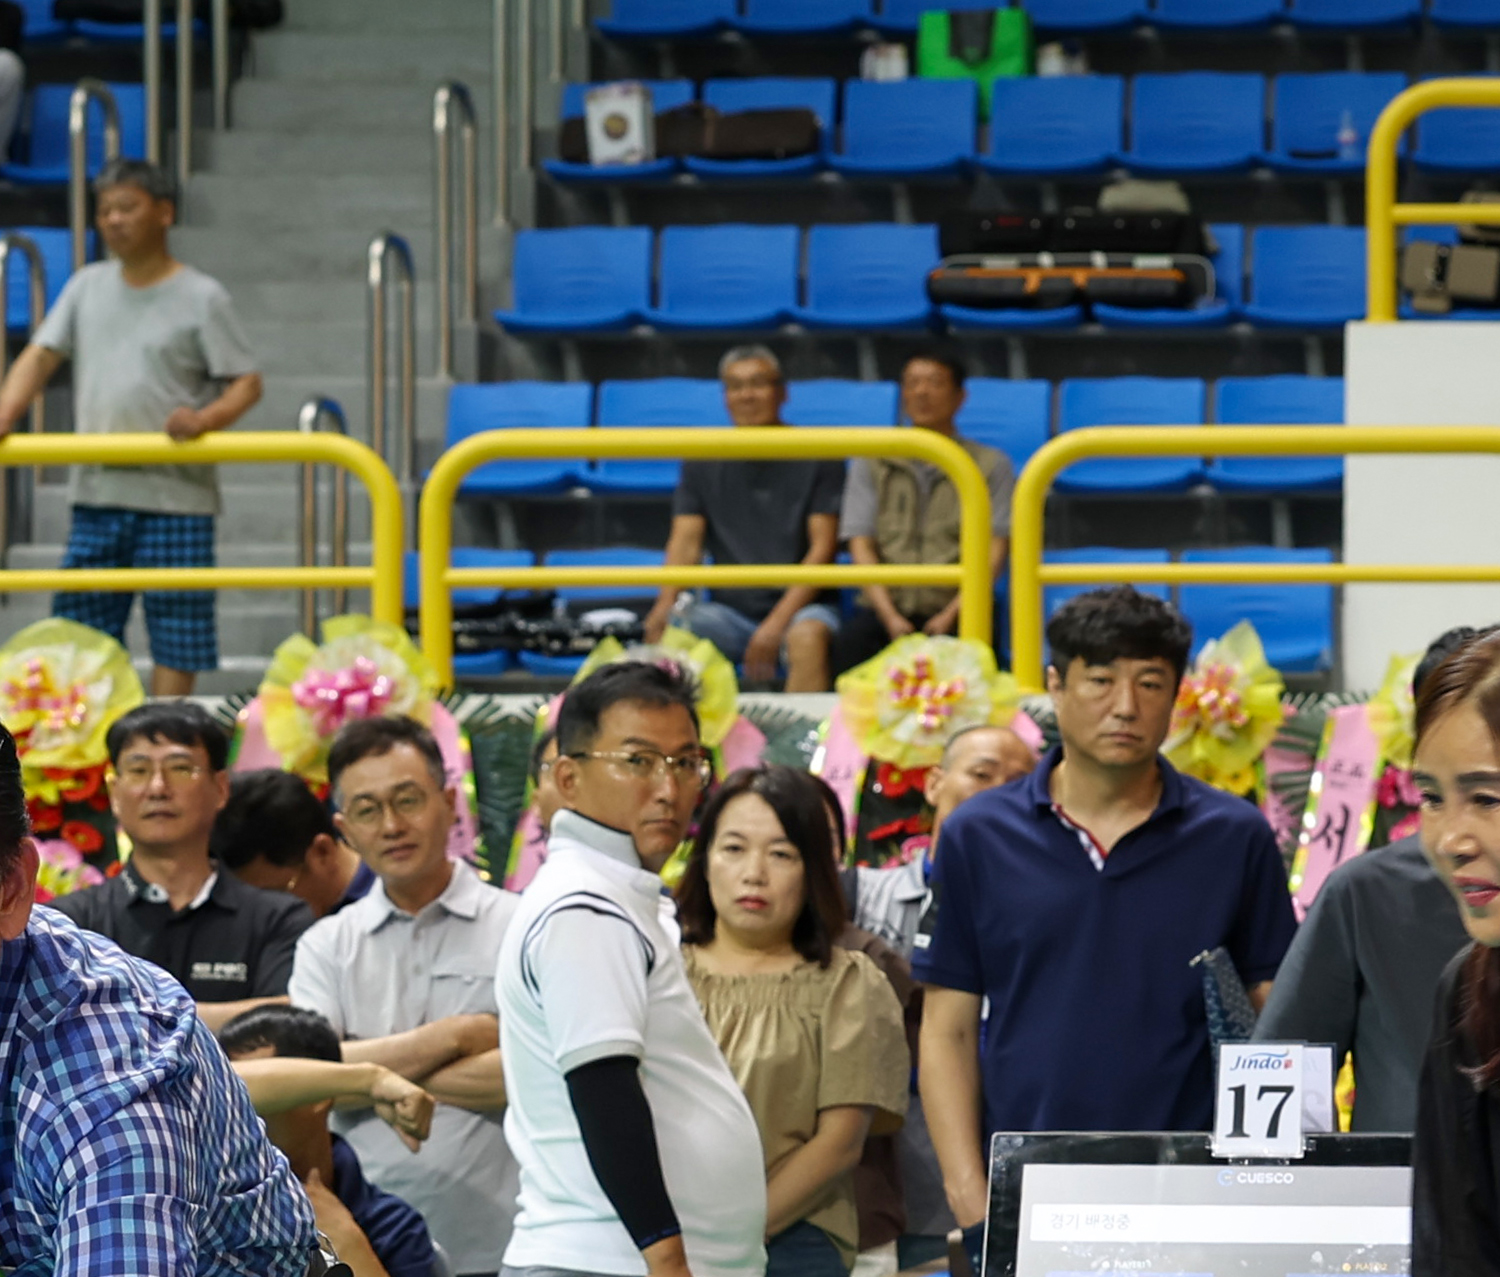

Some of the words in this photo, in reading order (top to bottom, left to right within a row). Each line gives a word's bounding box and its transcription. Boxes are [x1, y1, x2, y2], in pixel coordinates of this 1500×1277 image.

[1229, 1053, 1282, 1071] Jindo
[1225, 1084, 1295, 1139] 17
[1237, 1172, 1294, 1184] CUESCO
[1050, 1213, 1080, 1230] 경기
[1085, 1213, 1131, 1230] 배정중
